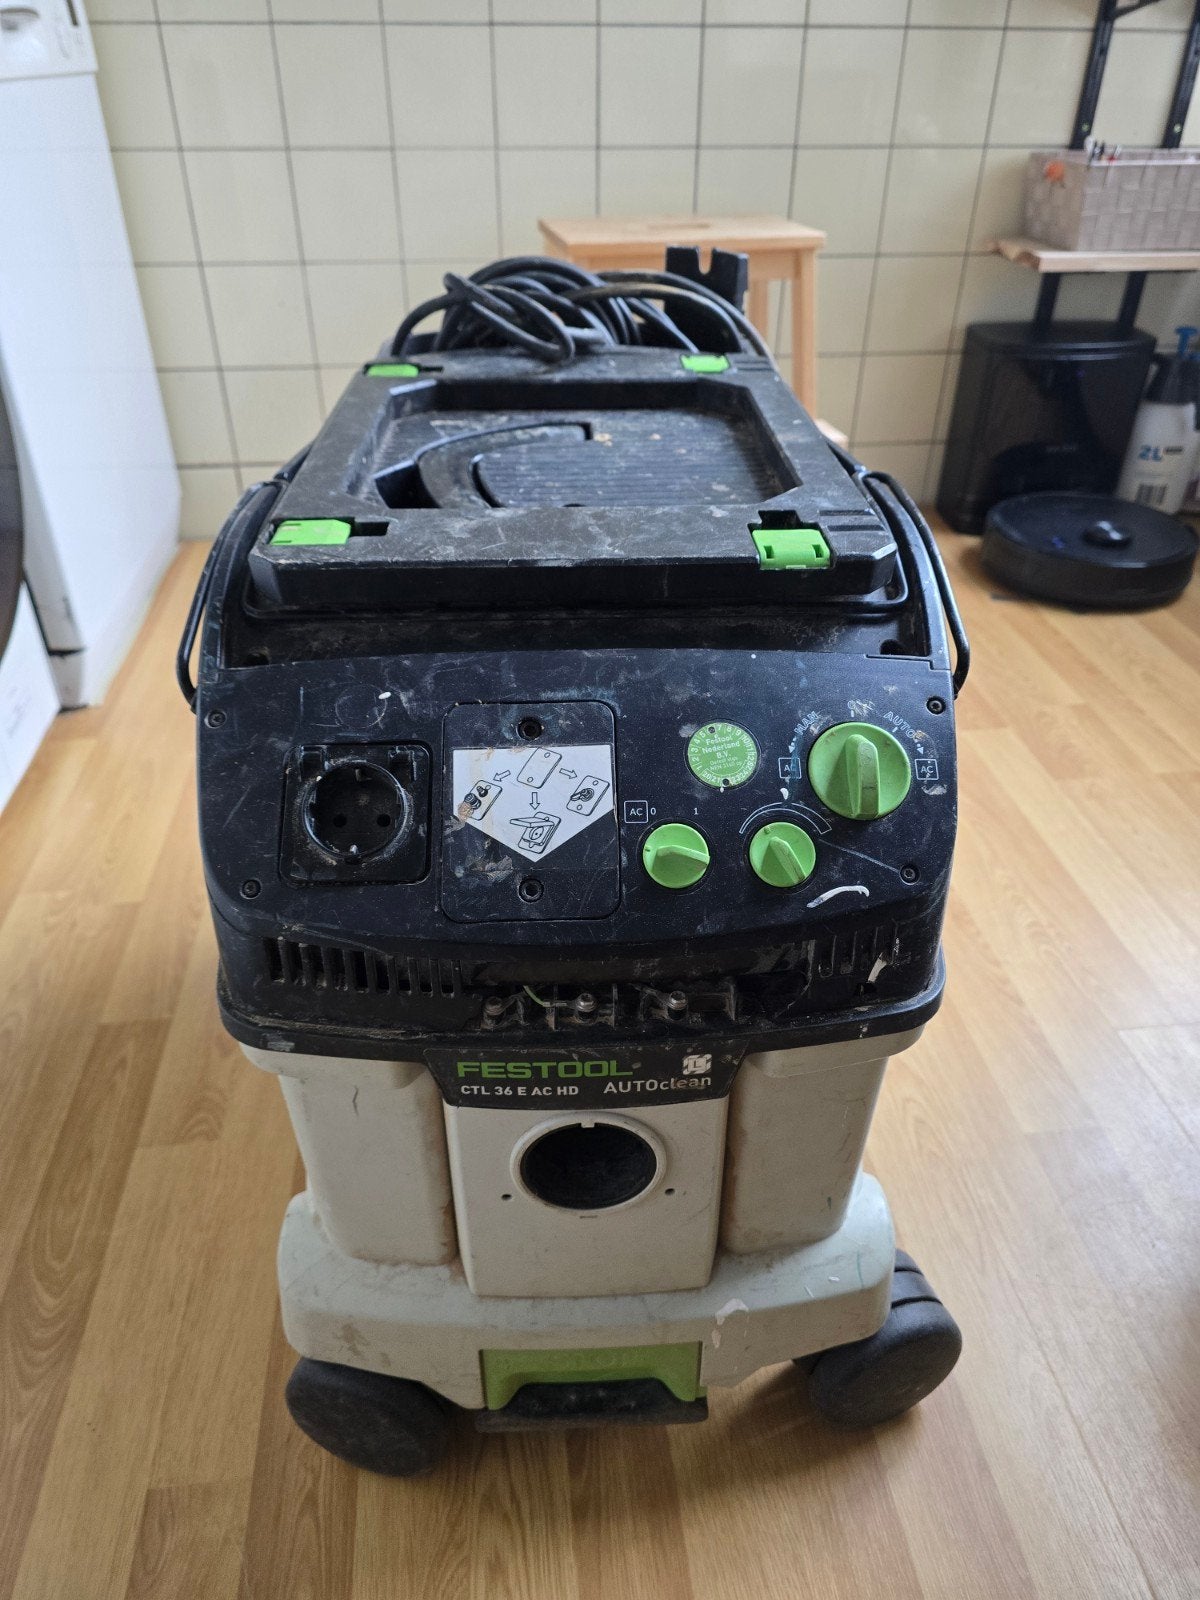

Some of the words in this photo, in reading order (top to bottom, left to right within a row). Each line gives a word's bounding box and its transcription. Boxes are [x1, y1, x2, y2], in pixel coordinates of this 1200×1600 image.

[883, 711, 915, 739] AUTO
[705, 735, 734, 745] Festool
[702, 740, 741, 754] Nederland
[920, 765, 934, 774] AC
[629, 807, 643, 816] AC
[650, 807, 657, 815] 0
[693, 807, 699, 815] 1
[456, 1060, 633, 1079] FESTOOL
[460, 1085, 491, 1095] CTL
[494, 1086, 513, 1096] 36
[517, 1086, 527, 1096] E
[531, 1086, 553, 1096] AC
[557, 1085, 579, 1096] HD
[603, 1077, 712, 1094] AUTOclean
